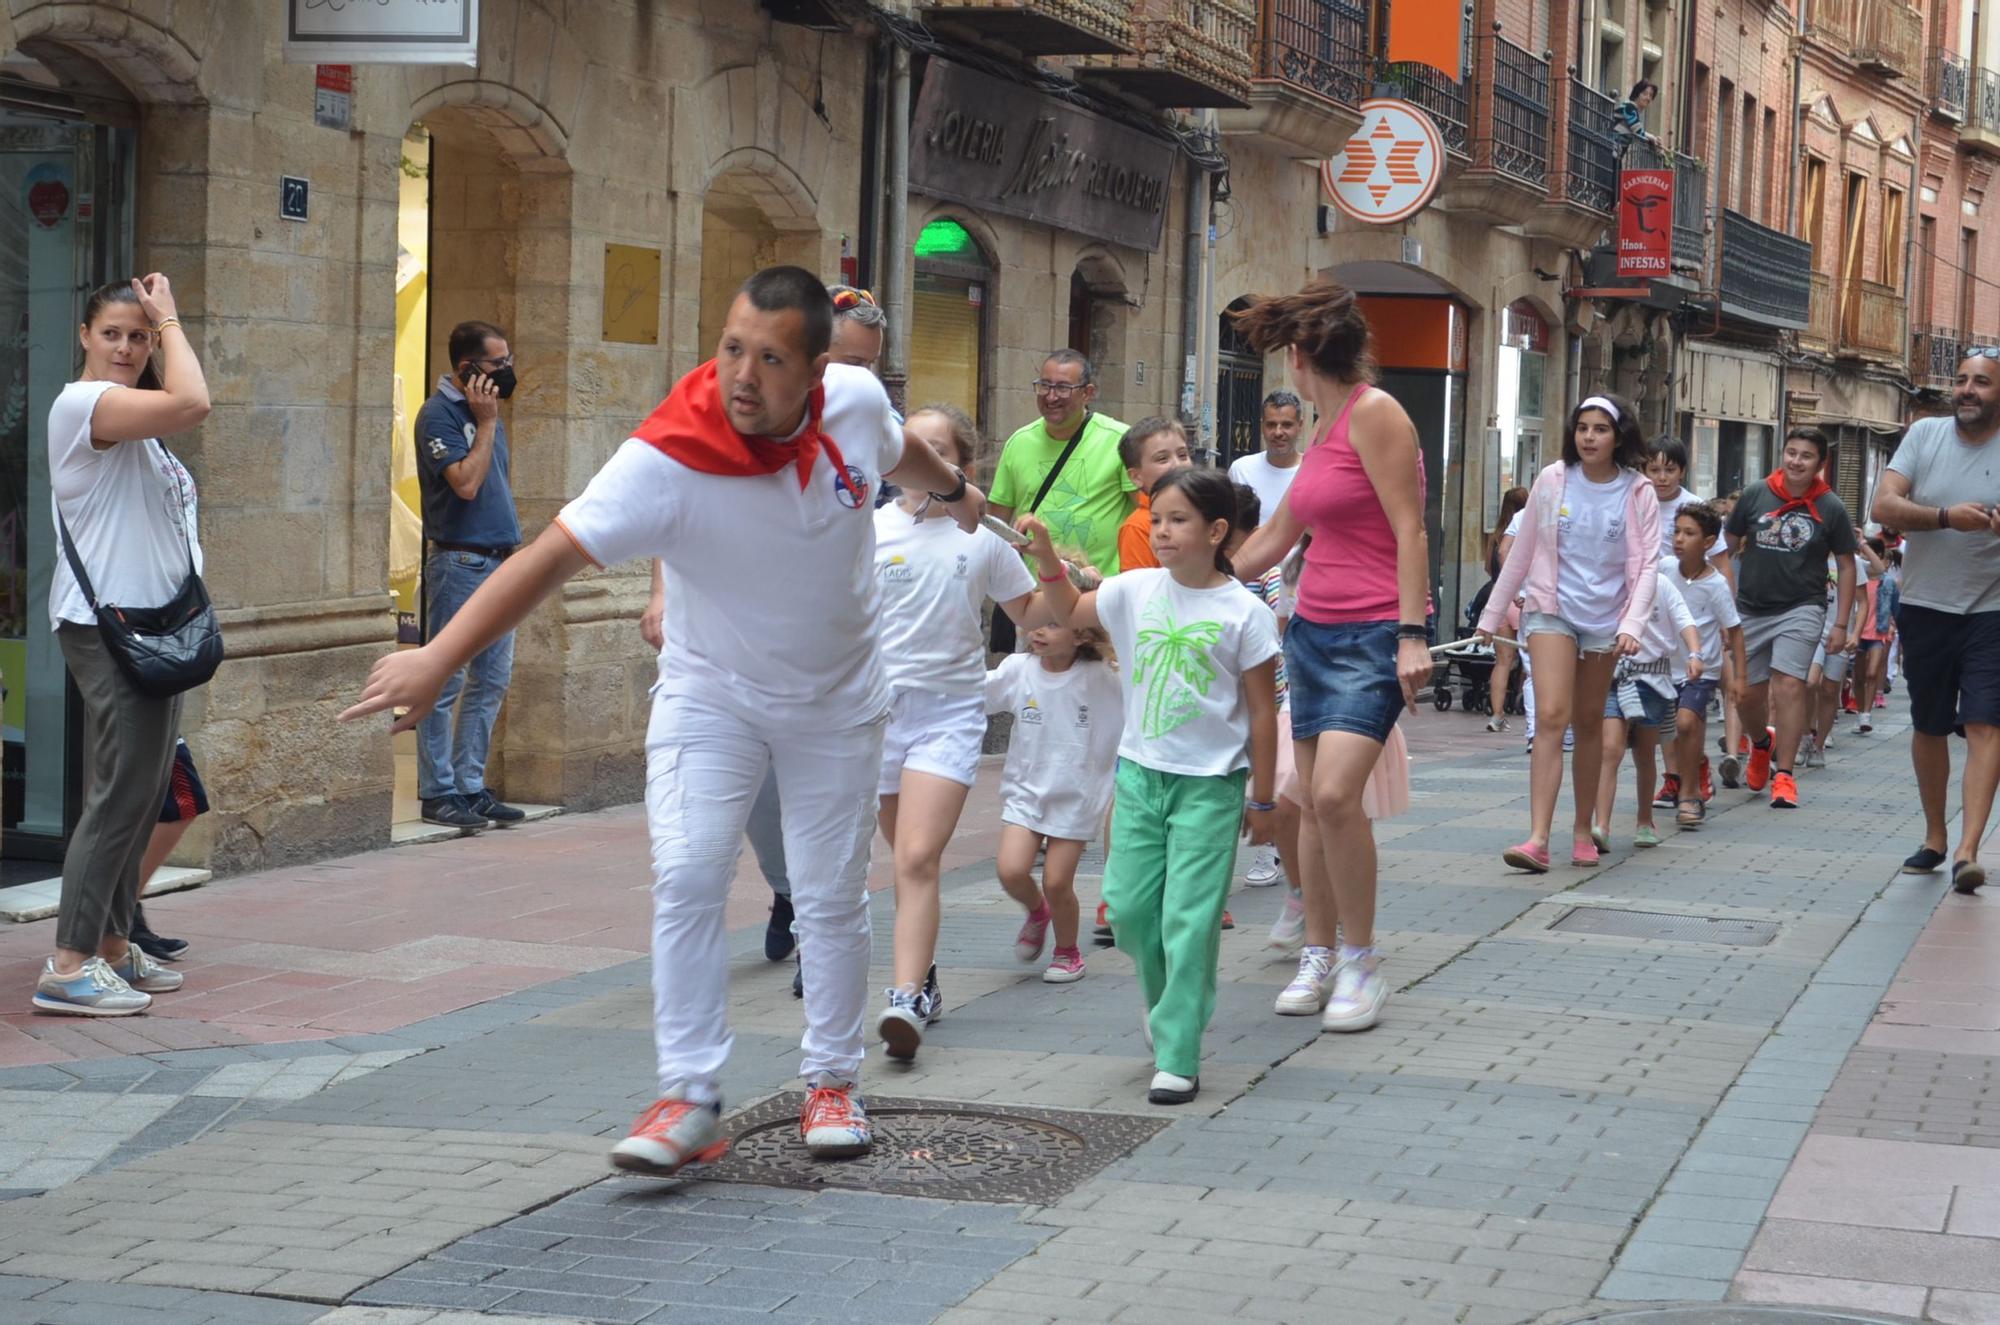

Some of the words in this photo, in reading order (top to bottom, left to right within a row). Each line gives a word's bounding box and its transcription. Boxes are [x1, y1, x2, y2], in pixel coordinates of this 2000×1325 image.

[926, 109, 1005, 166] JOYERIA
[1085, 156, 1164, 215] RELOJERIA
[1623, 175, 1669, 191] CARNICERIAS
[288, 182, 304, 213] 20
[1621, 239, 1647, 251] Hnos.
[1620, 257, 1666, 270] INFESTAS
